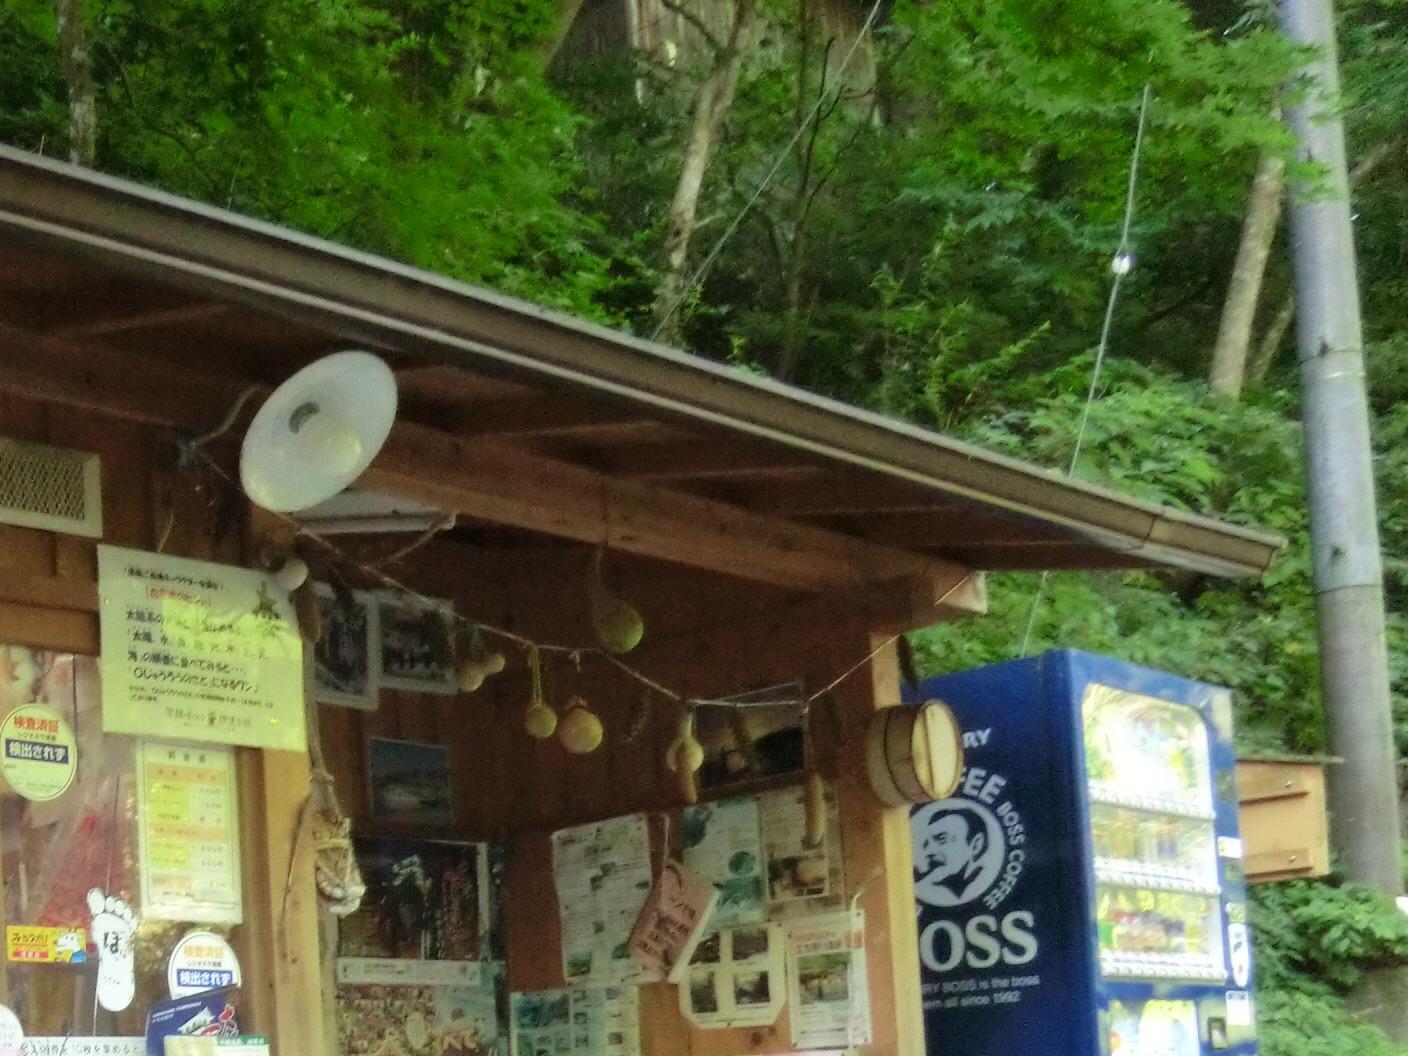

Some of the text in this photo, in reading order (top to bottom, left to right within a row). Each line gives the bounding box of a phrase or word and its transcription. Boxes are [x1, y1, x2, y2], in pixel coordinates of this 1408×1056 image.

[7, 741, 67, 764] 検出されず
[962, 728, 991, 749] RY
[959, 767, 1008, 804] EE
[997, 801, 1026, 847] BOSS
[918, 910, 1039, 973] OSS
[179, 970, 232, 987] 検出されず
